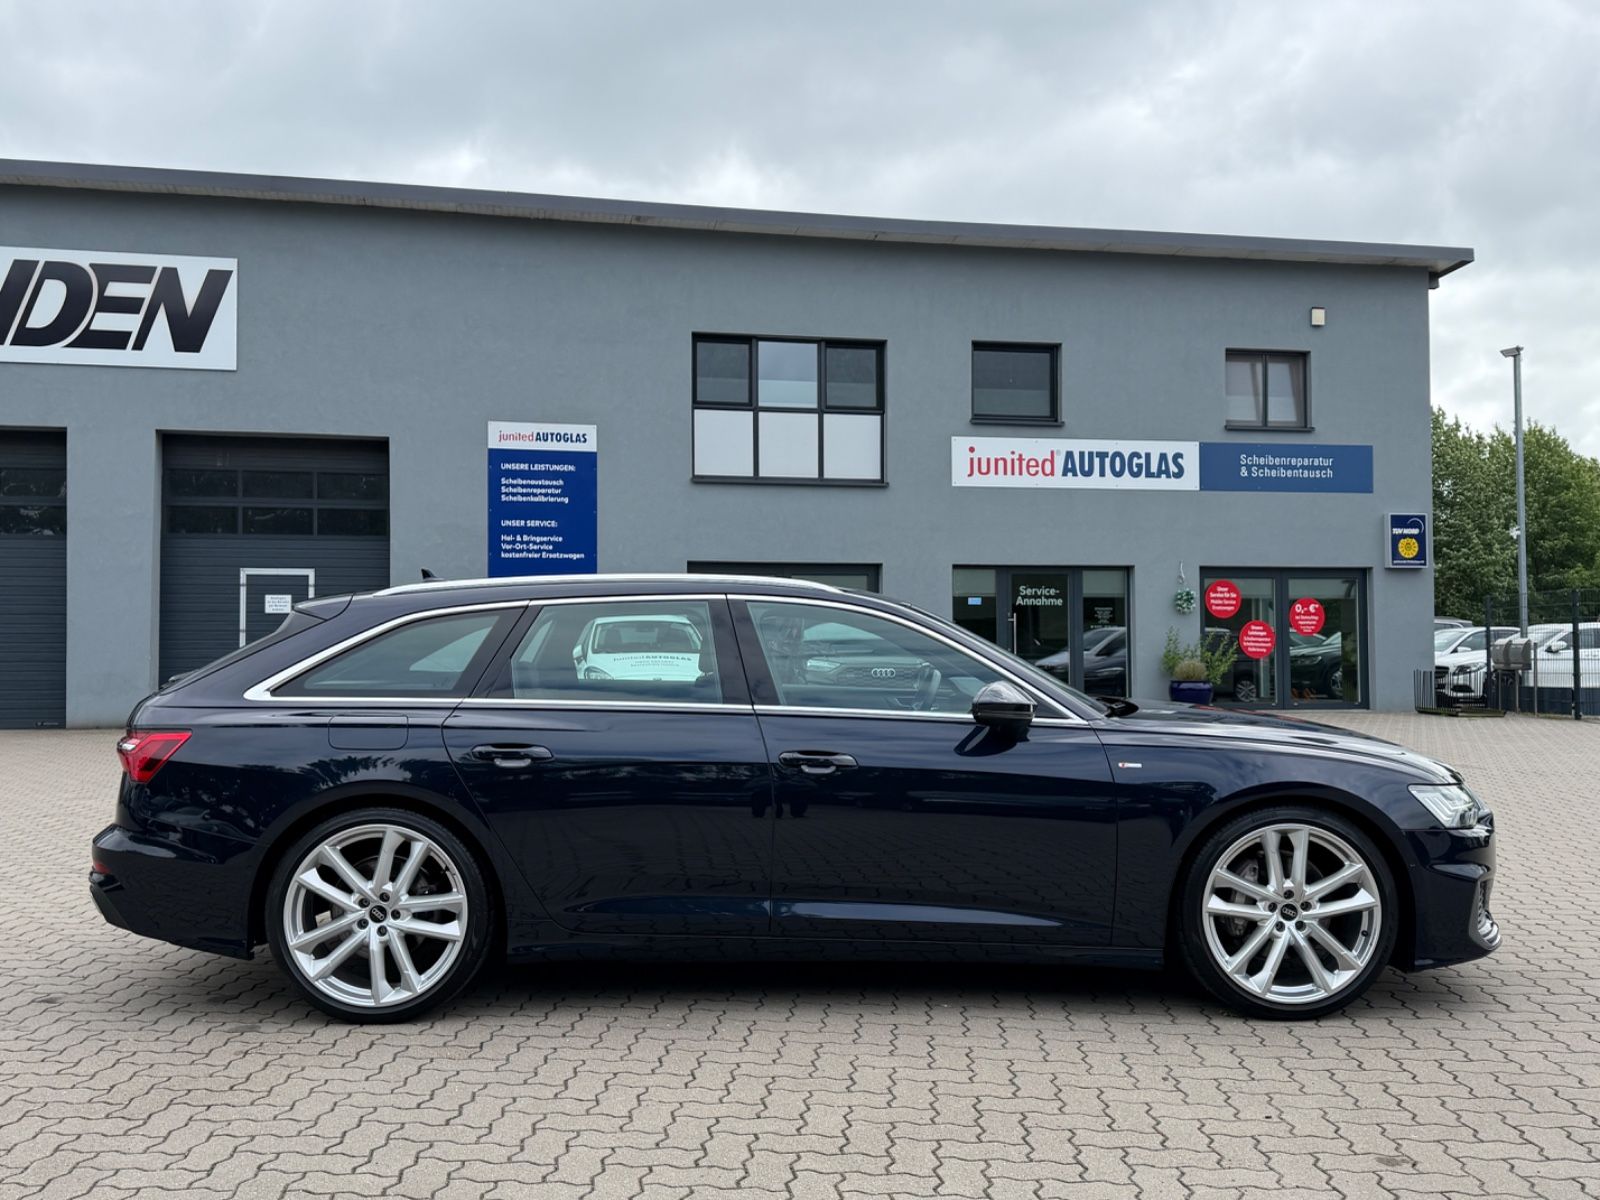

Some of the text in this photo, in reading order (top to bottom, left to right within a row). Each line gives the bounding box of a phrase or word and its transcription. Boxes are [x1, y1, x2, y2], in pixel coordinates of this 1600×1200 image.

[498, 430, 587, 443] junited AUTOGLAS
[967, 446, 1185, 479] junited AUTOGLAS
[1239, 454, 1334, 467] Scheibenreparatur
[500, 463, 576, 472] UNSERE LEISTUNGEN:
[1240, 466, 1333, 478] & Scheibentausch
[500, 477, 564, 486] Scheibenaustausch
[500, 486, 562, 494] Scheibenreparatur
[500, 494, 569, 504] Scheibenkalibrierung
[501, 520, 558, 528] UNSER SERVICE:
[522, 534, 563, 543] Bringservice
[501, 543, 553, 551] Vor-Ort-Service
[501, 551, 585, 560] kostenfreier Ersatzwagen
[1019, 585, 1060, 596] Service-
[1016, 596, 1063, 606] Annahme
